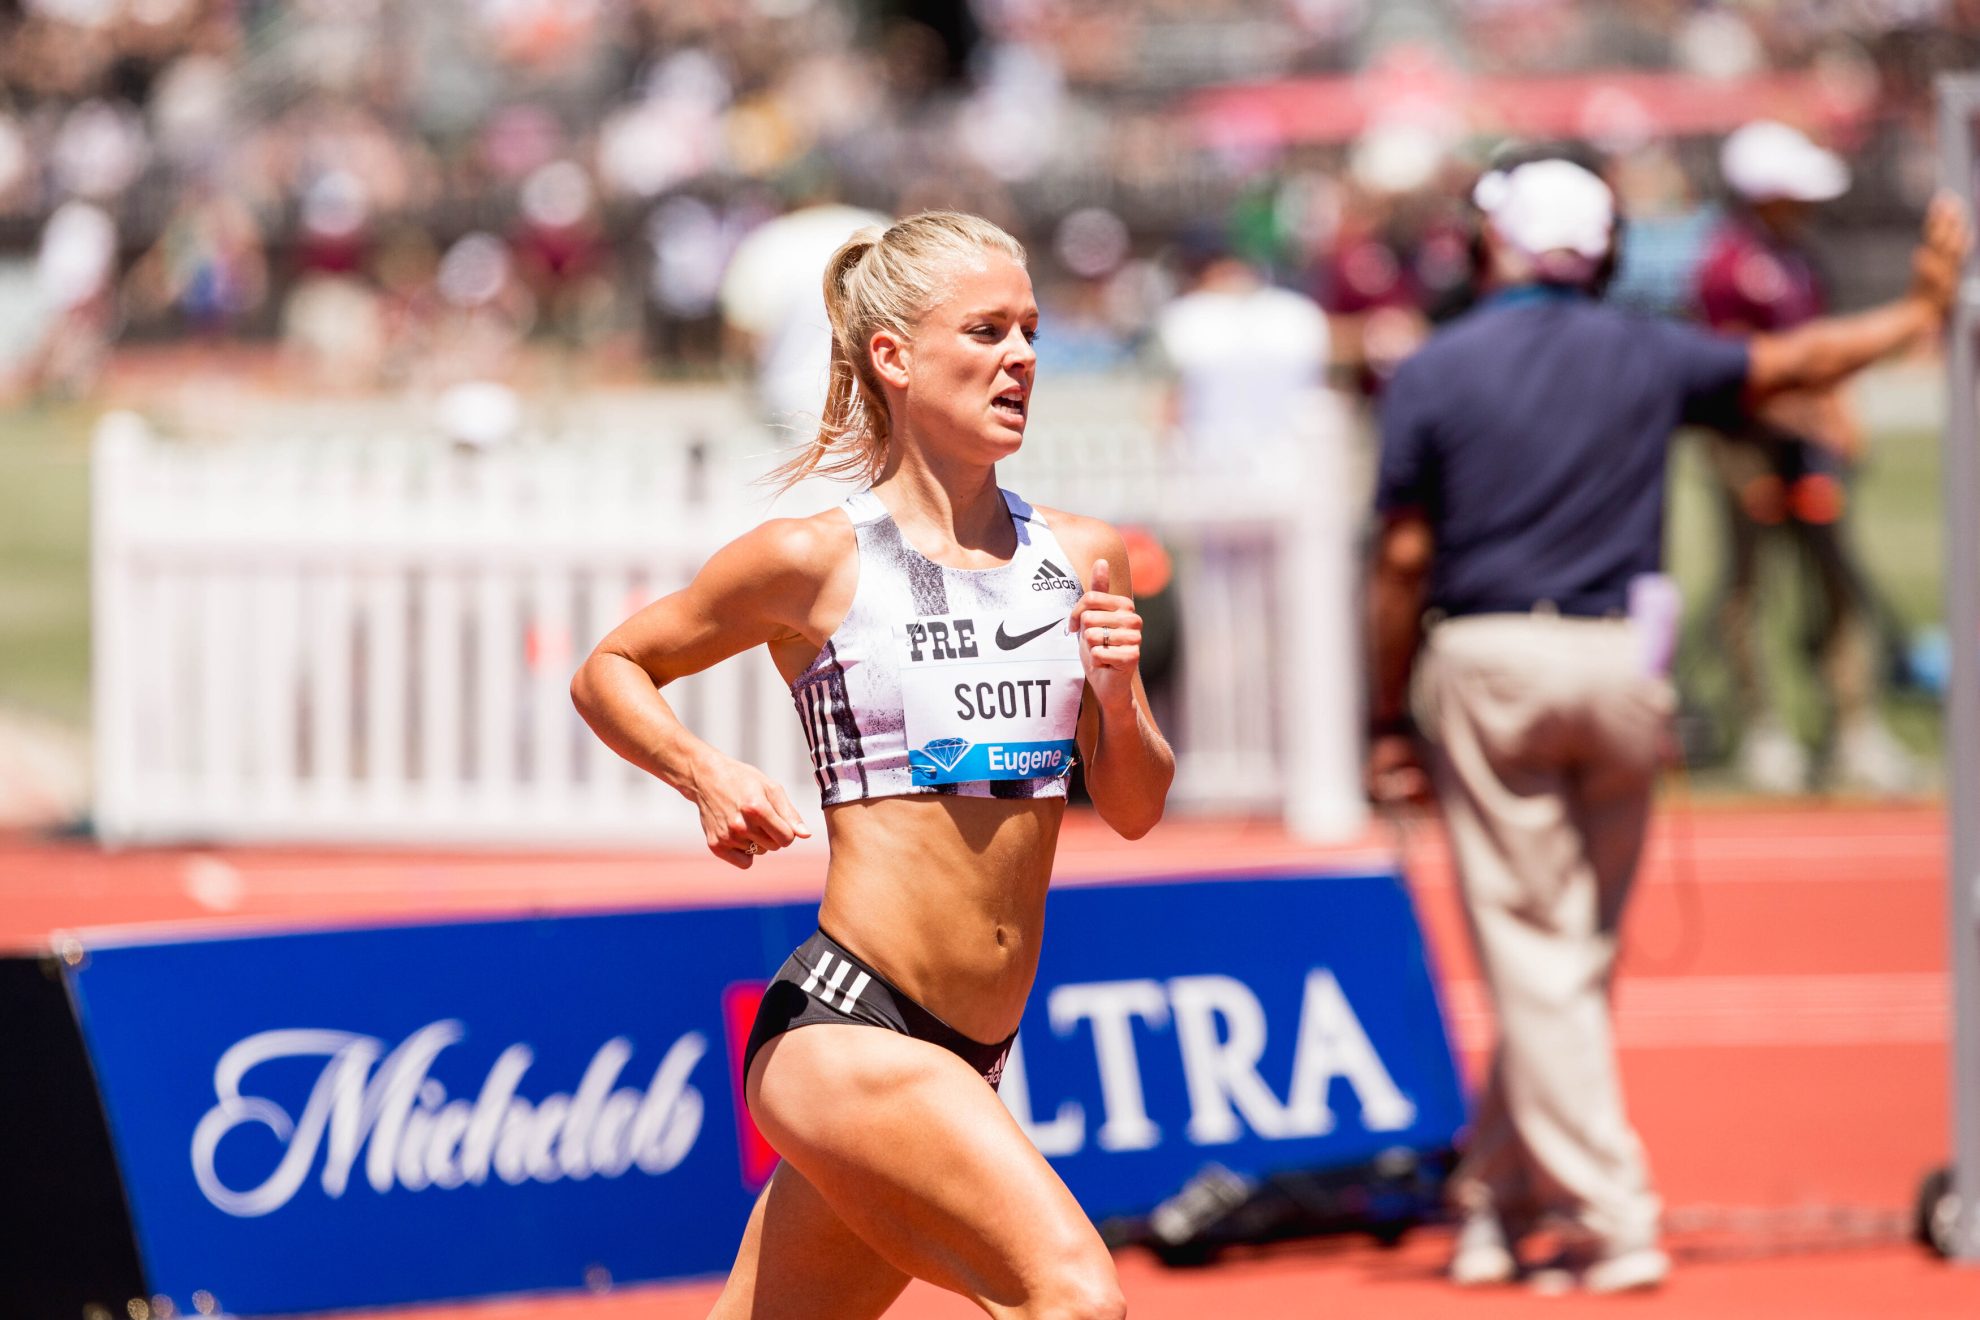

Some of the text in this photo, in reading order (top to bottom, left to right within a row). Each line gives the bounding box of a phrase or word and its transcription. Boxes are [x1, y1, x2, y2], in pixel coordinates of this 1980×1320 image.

[1031, 578, 1076, 592] adidas
[905, 619, 979, 662] PRE
[954, 679, 1052, 721] SCOTT
[987, 746, 1062, 775] Eugene
[190, 967, 1416, 1217] Michelob LTRA
